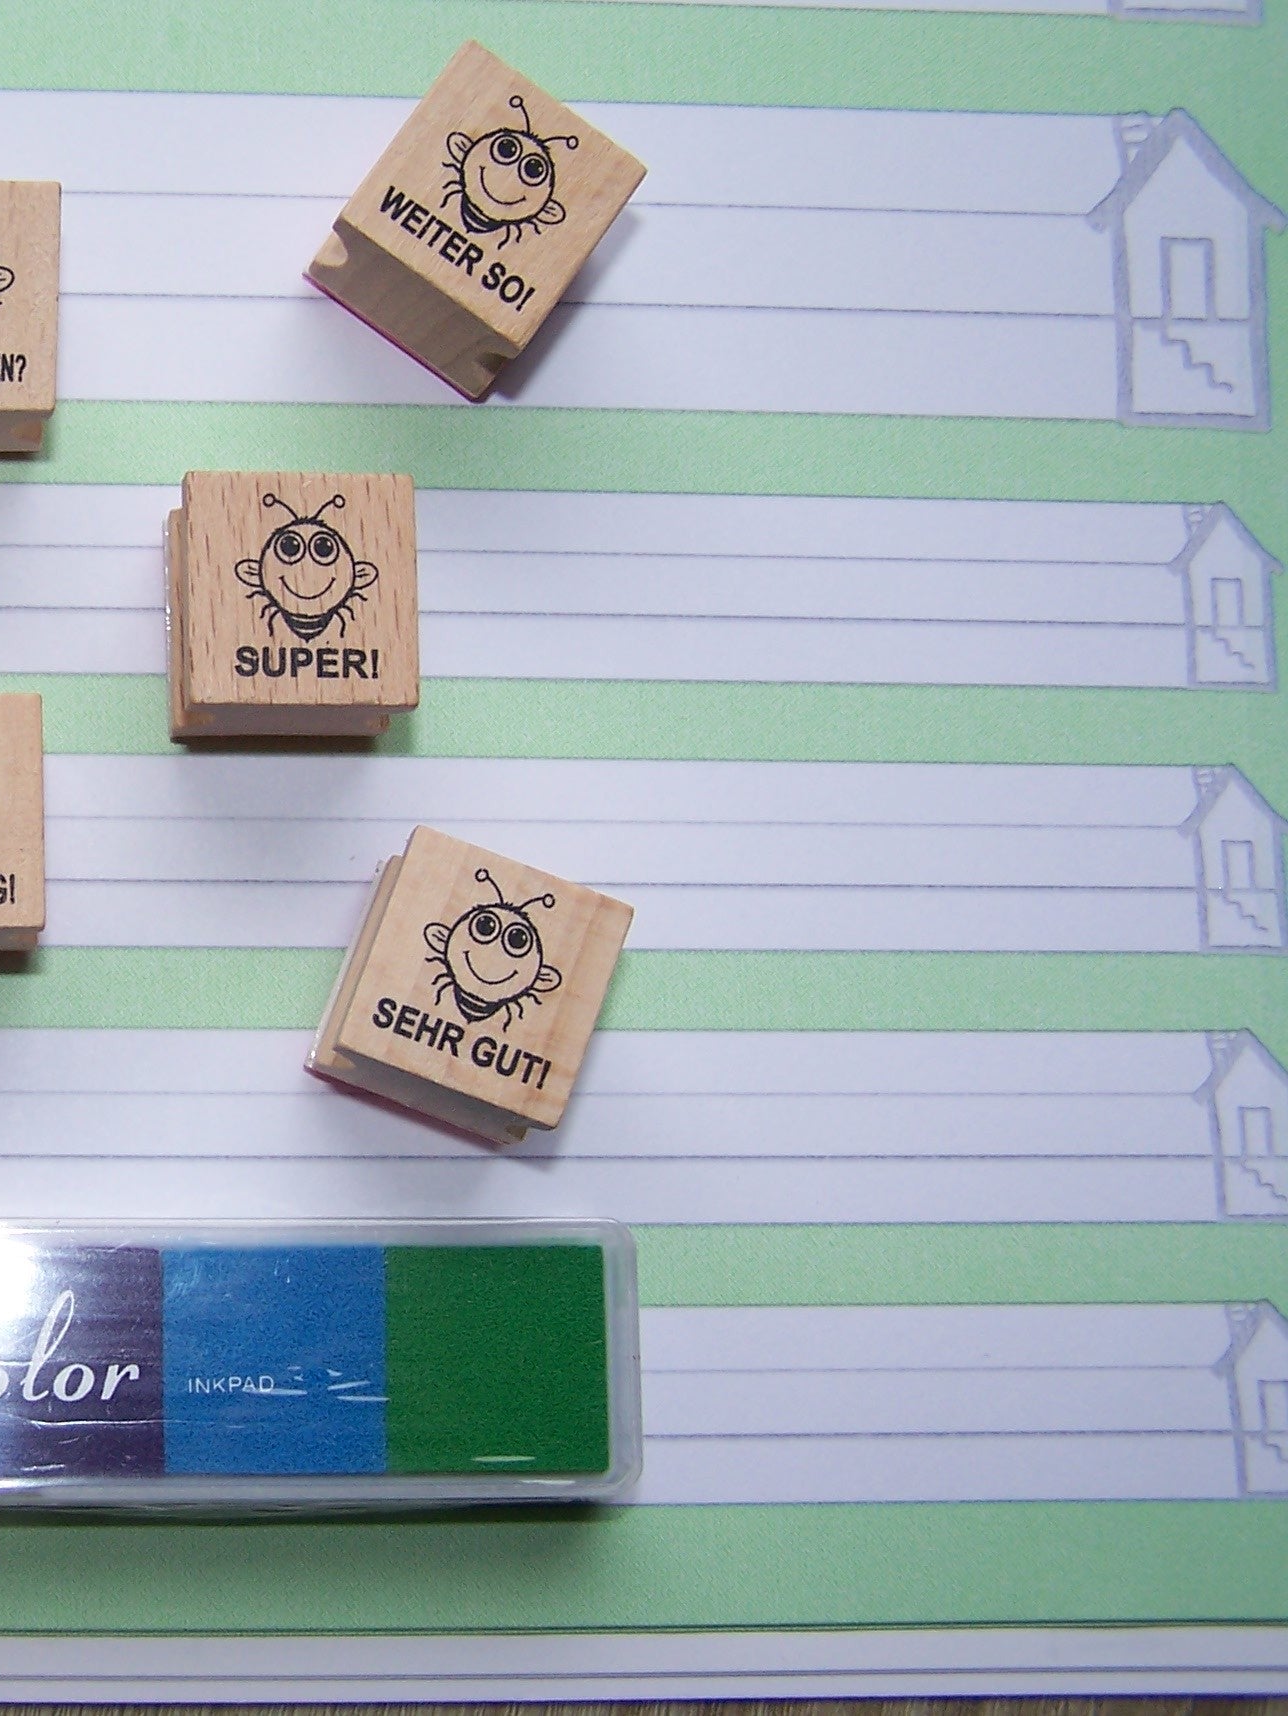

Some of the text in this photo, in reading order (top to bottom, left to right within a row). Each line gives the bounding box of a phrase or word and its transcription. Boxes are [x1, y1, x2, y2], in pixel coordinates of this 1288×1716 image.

[379, 185, 536, 312] WEITER SO!
[234, 646, 379, 679] SUPER!
[372, 997, 552, 1090] SEHR GUT!
[187, 1376, 274, 1394] INKPAD
